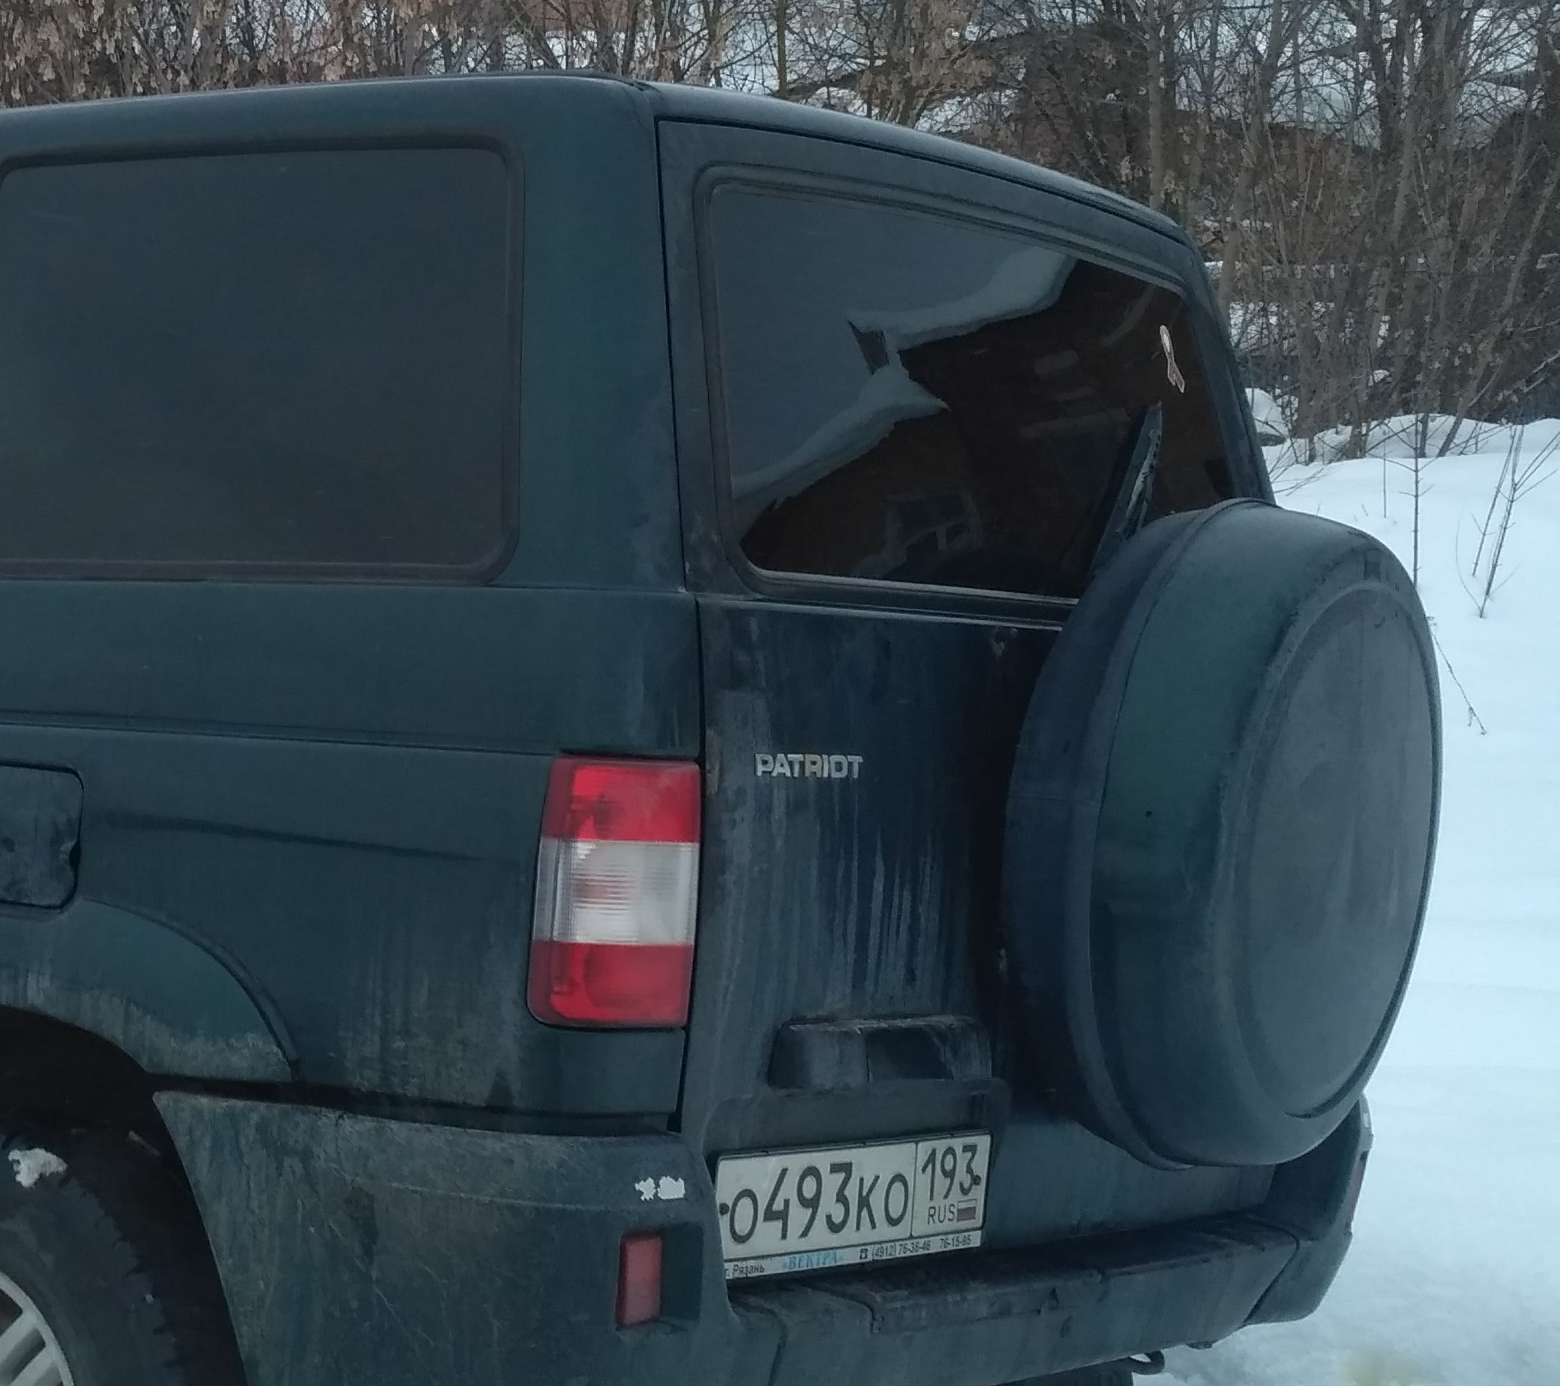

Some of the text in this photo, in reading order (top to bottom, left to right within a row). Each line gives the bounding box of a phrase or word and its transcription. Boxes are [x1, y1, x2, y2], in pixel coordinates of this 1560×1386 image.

[754, 753, 863, 778] PATRIOT
[922, 1144, 978, 1202] 193
[927, 1203, 956, 1225] RUS
[733, 1264, 765, 1275] Рязань
